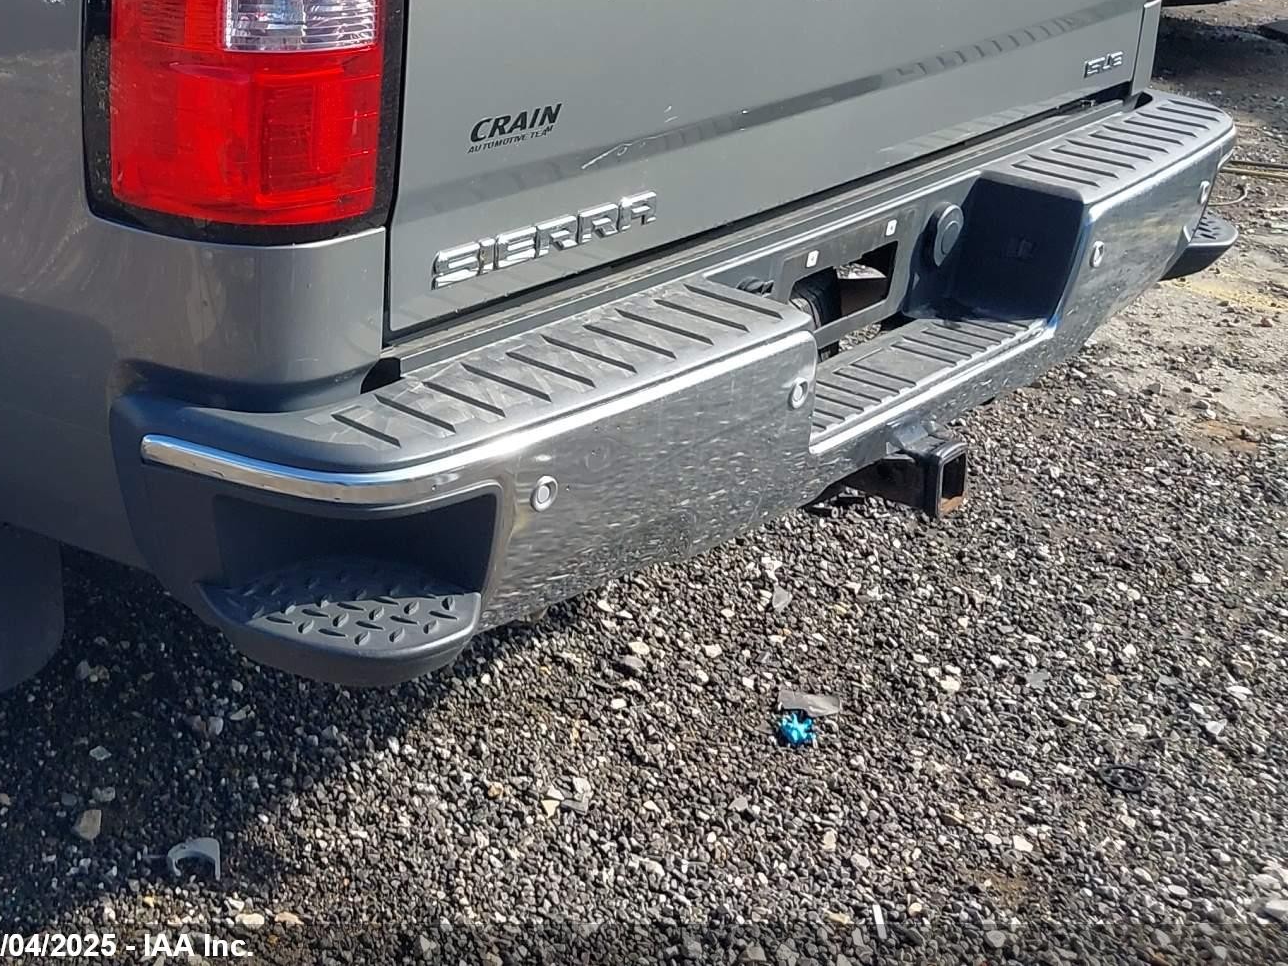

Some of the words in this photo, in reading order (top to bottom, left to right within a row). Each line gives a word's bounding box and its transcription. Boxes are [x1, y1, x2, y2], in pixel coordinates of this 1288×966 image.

[1083, 51, 1124, 78] SLE
[467, 134, 528, 154] AUTOMOTIVE
[529, 124, 554, 139] TEAM
[470, 103, 563, 143] CRAIN
[431, 191, 657, 290] SIERRA
